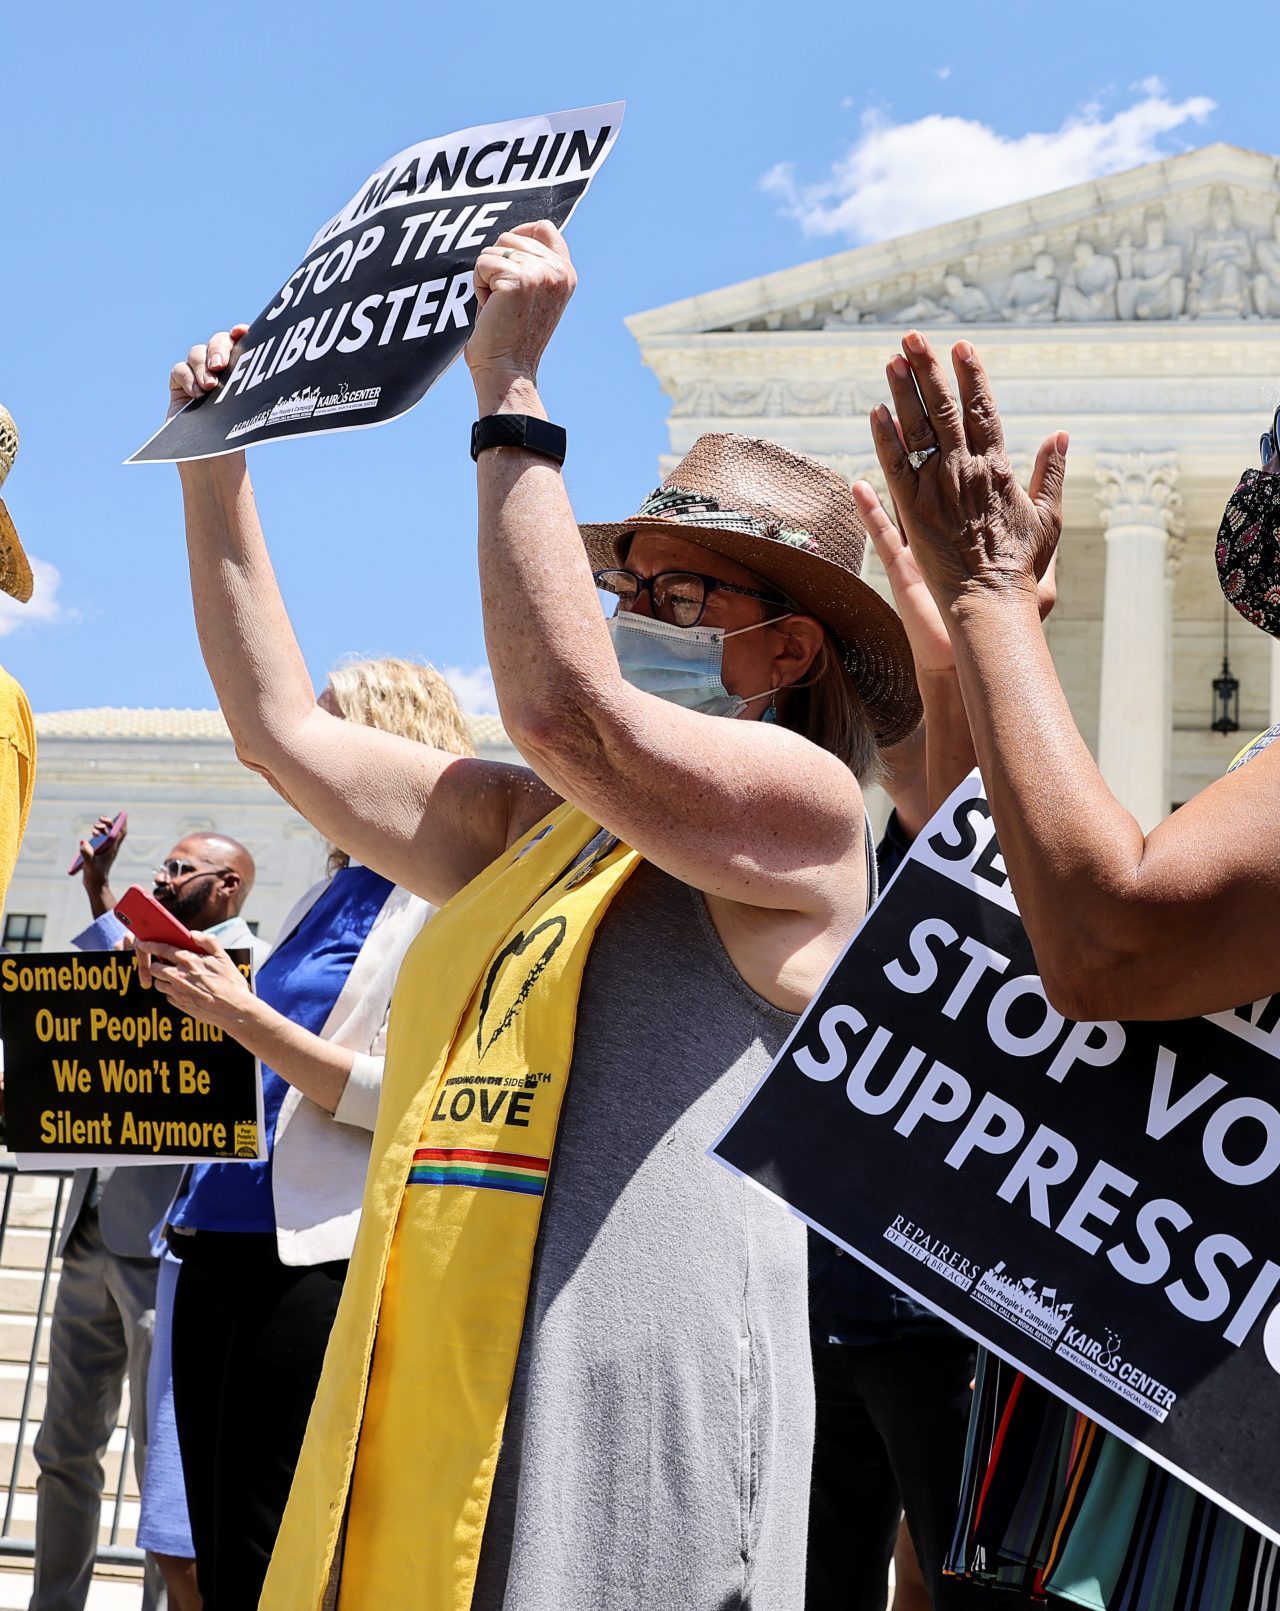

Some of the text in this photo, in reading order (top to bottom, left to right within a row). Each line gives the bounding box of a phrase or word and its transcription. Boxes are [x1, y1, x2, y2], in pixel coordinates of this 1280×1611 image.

[350, 126, 611, 222] MANCHIN
[266, 225, 386, 321] STOP
[391, 200, 513, 267] THE
[214, 270, 476, 405] FILIBUSTER
[348, 386, 382, 402] CENTER
[2, 957, 139, 996] Somebody'
[883, 918, 1127, 1083] STOP
[35, 1008, 82, 1042] Our
[90, 1007, 172, 1048] People
[52, 1059, 211, 1094] We Won't Be
[503, 1077, 524, 1088] SIDE
[40, 1110, 227, 1152] Silent Anymore
[431, 1087, 535, 1127] LOVE
[886, 1229, 970, 1290] OF THE BREACH
[891, 1213, 981, 1280] REPAIRERS
[976, 1292, 999, 1311] NATIONAL
[999, 1305, 1011, 1318] CALL
[1017, 1318, 1035, 1333] MORAL
[979, 1279, 1060, 1337] Poor People's Campaign
[1058, 1346, 1071, 1357] FOR
[1098, 1371, 1118, 1388] RIGHTS
[1123, 1388, 1142, 1405] SOCIAL
[1063, 1326, 1177, 1410] KAIROS CENTER
